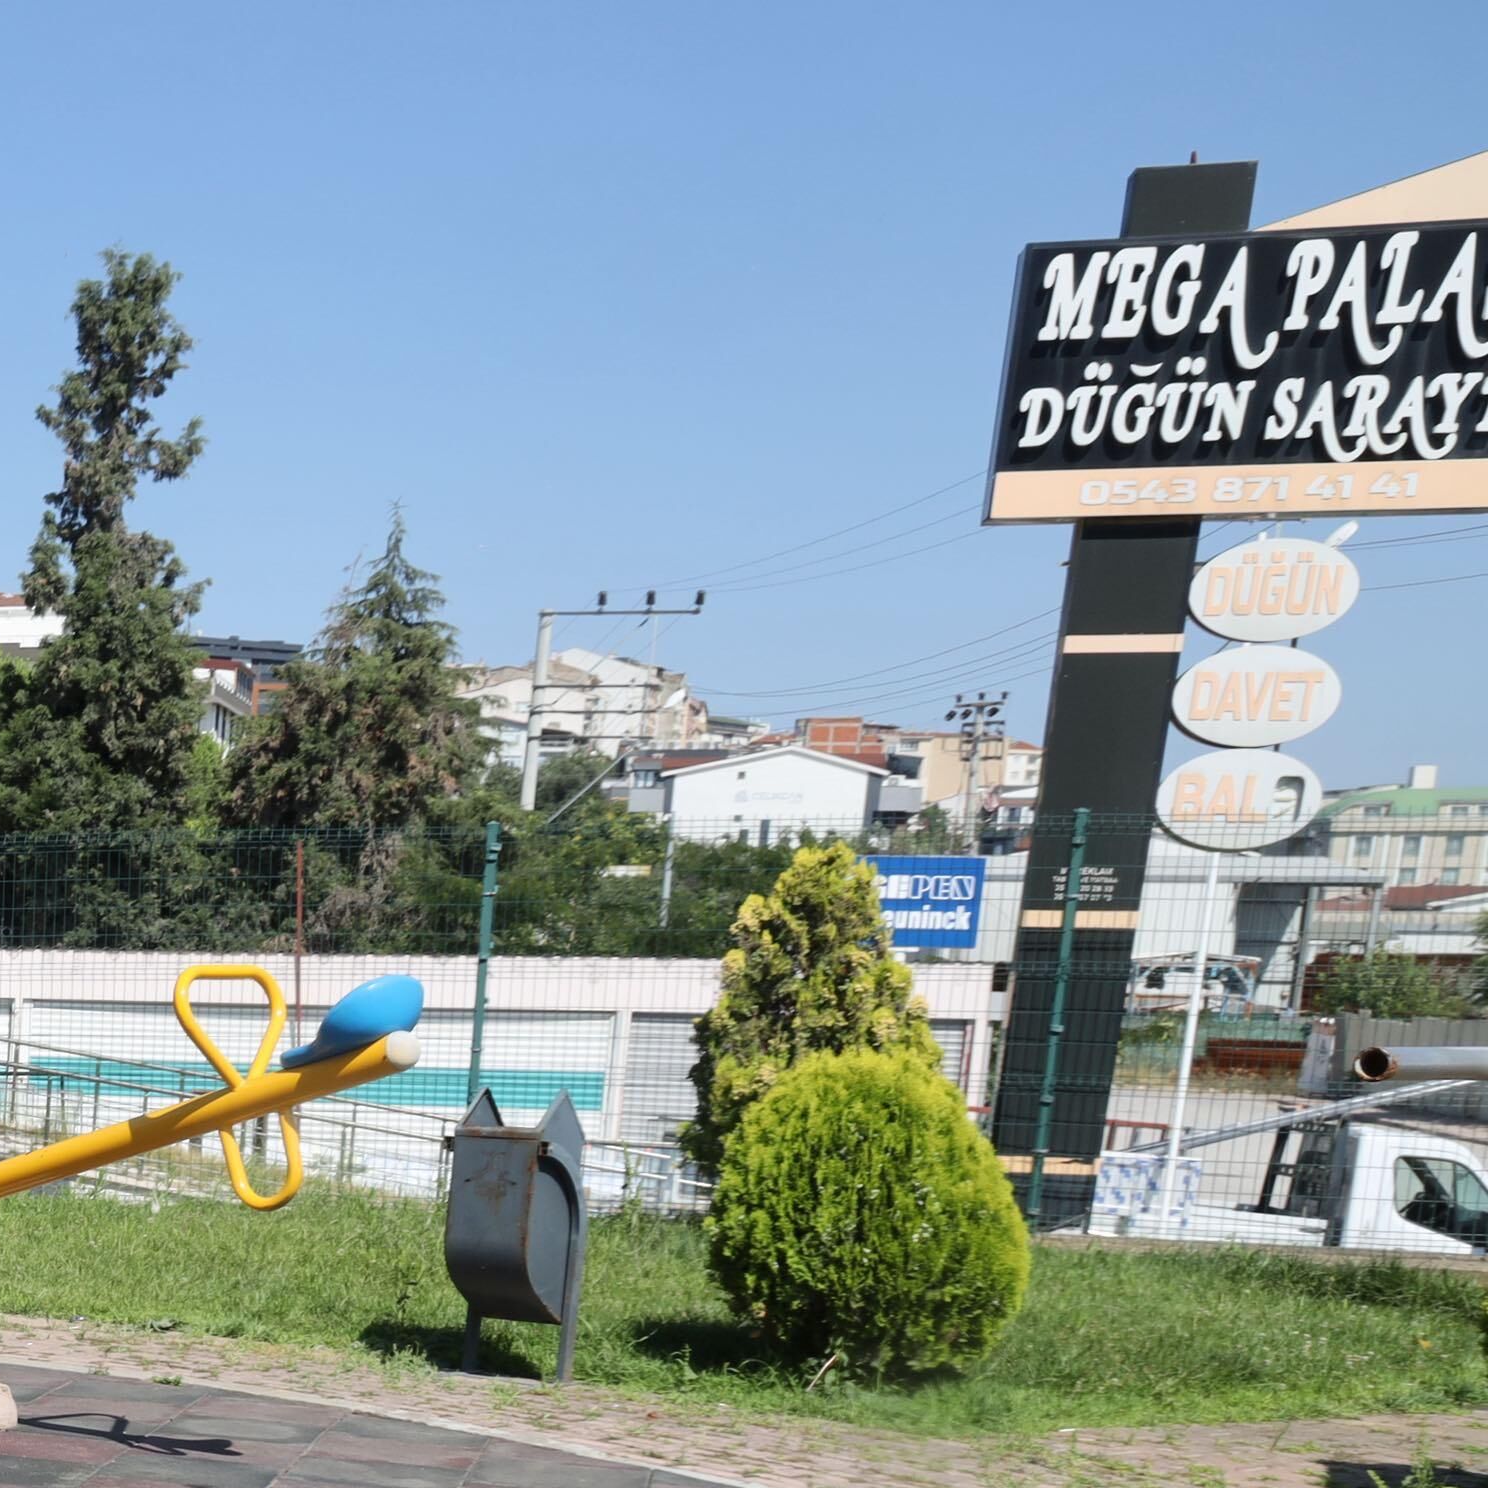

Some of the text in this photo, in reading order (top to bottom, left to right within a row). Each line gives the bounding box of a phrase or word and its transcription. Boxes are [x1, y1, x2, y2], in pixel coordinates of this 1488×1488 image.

[1037, 230, 1488, 370] MEGA PALA
[1018, 356, 1255, 448] DÜĞÜN
[1080, 470, 1419, 506] 0543 871 41 41
[1203, 552, 1346, 618] DÜĞÜN
[1188, 671, 1325, 722] DAVET
[877, 874, 976, 900] GEPEN
[884, 904, 972, 930] euninck
